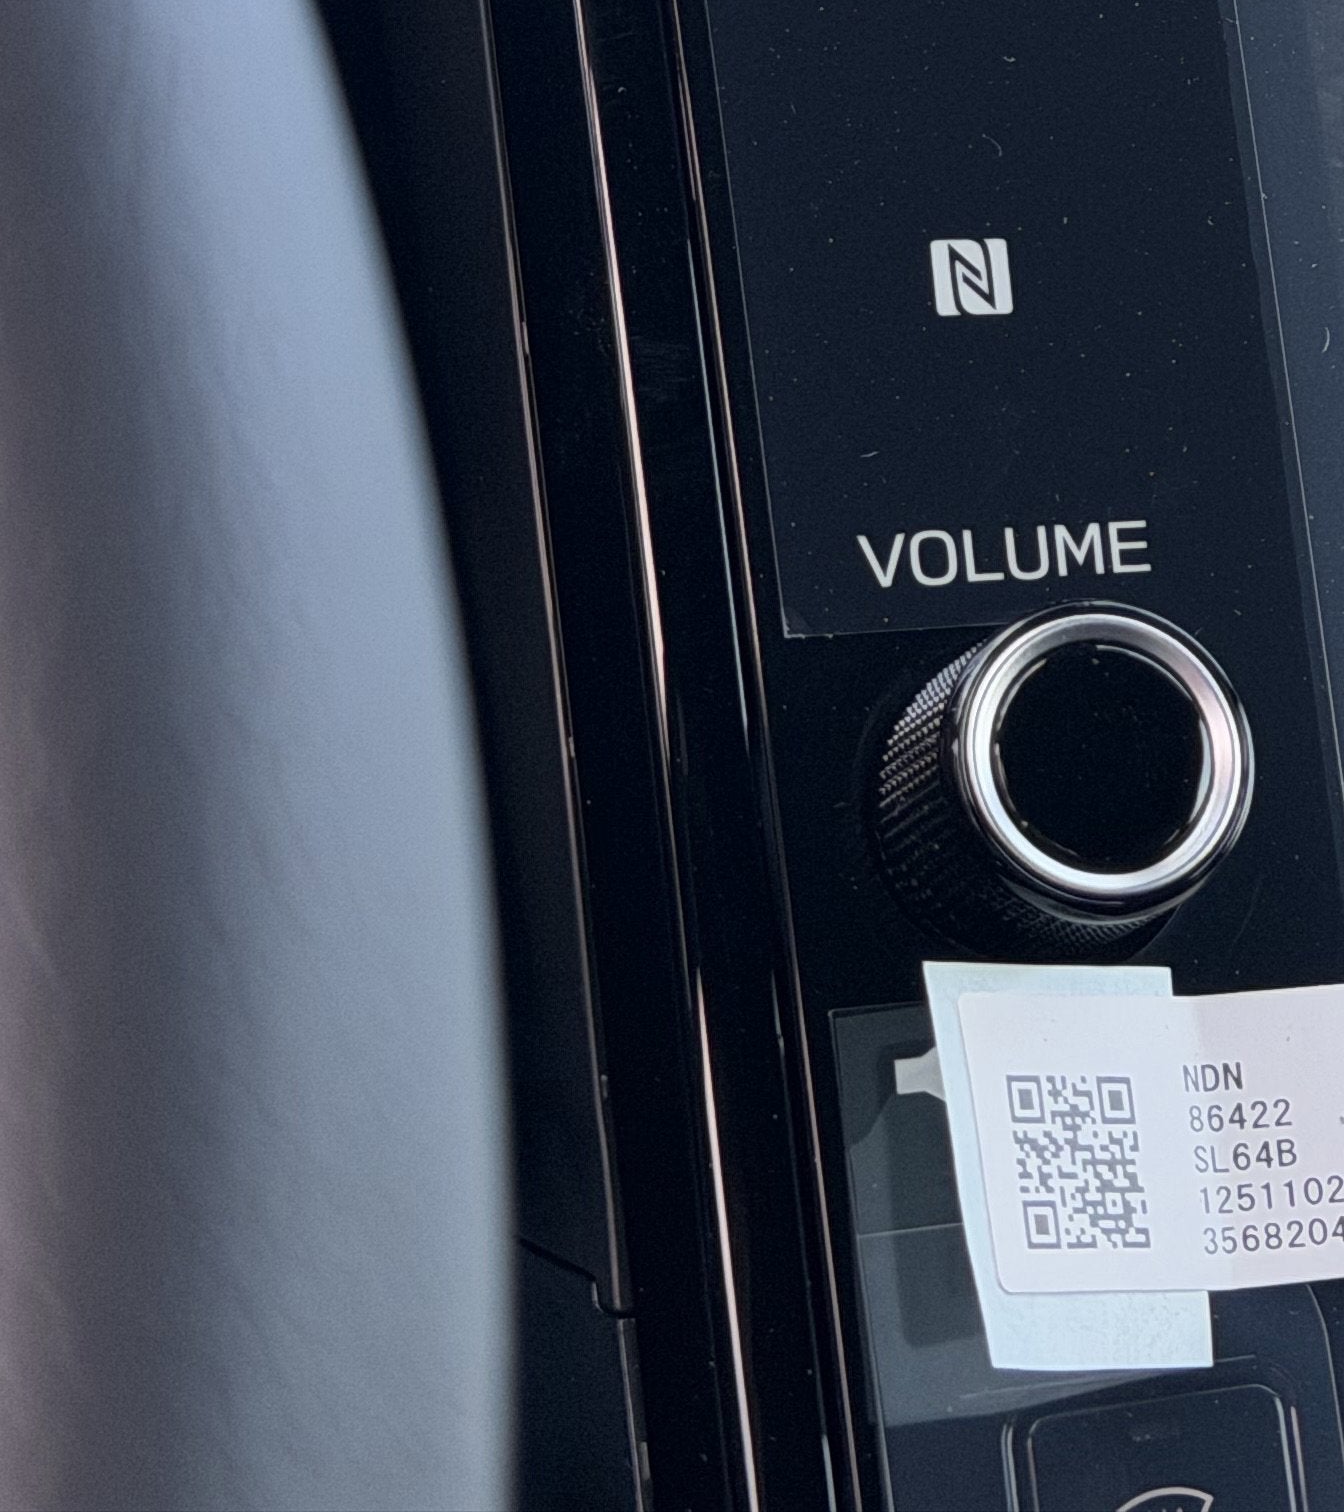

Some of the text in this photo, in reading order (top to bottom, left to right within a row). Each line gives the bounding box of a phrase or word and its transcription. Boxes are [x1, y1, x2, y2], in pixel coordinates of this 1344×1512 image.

[856, 519, 1153, 589] VOLUME
[1182, 1061, 1244, 1094] NDN
[1187, 1098, 1294, 1133] 86422
[1192, 1138, 1298, 1176] SL64B
